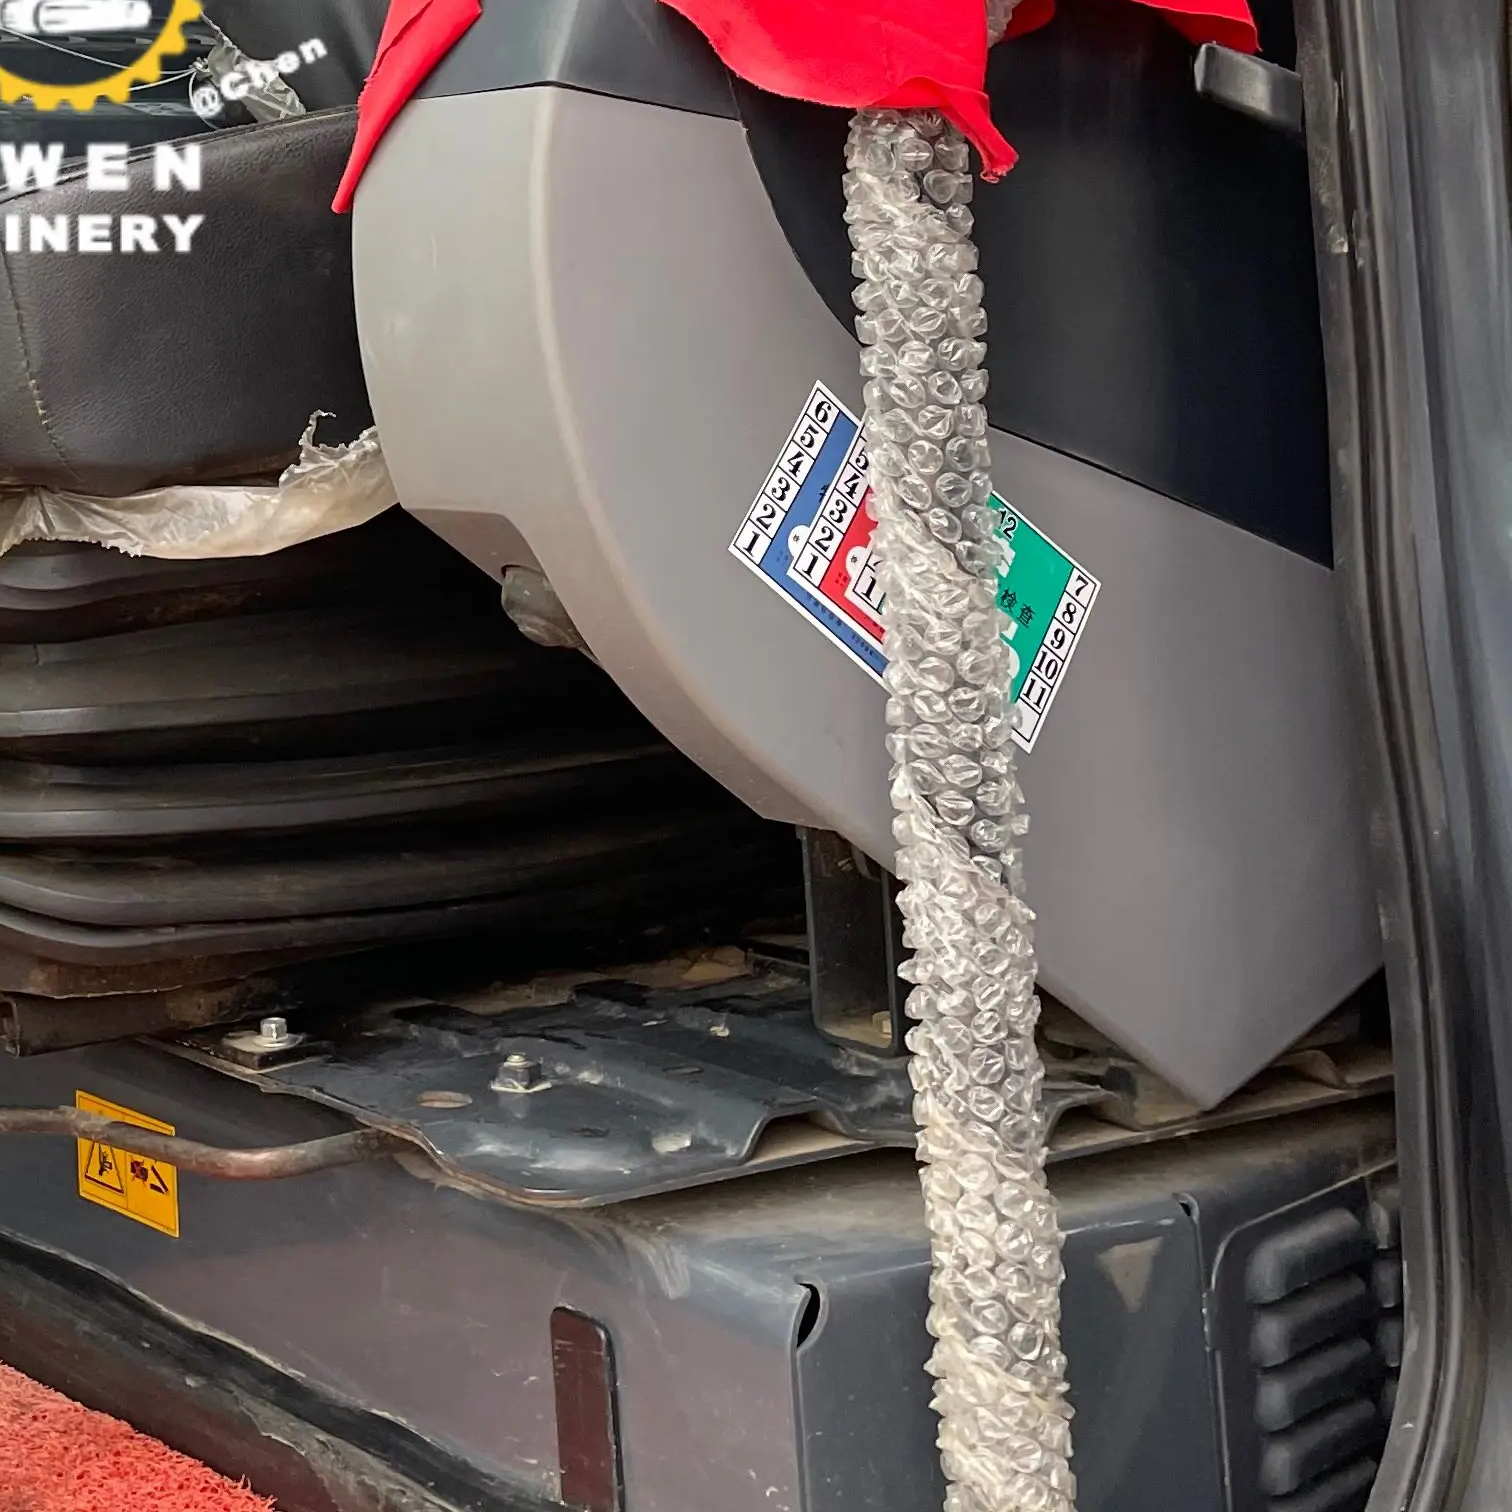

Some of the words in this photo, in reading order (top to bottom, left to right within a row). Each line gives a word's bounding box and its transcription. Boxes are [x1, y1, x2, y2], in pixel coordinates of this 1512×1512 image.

[815, 401, 831, 423] 6
[800, 425, 818, 448] 5
[788, 451, 804, 477] 4
[772, 477, 790, 501] 3
[844, 473, 860, 499] 4
[756, 504, 775, 530] 2
[829, 499, 847, 523] 3
[743, 531, 760, 557] 1
[815, 526, 834, 552] 2
[802, 553, 818, 578] 1
[862, 576, 876, 601] 1
[1076, 575, 1088, 596] 7
[1062, 603, 1076, 623] 8
[1051, 628, 1065, 649] 9
[1034, 651, 1058, 679] 10
[1023, 678, 1046, 708] 11
